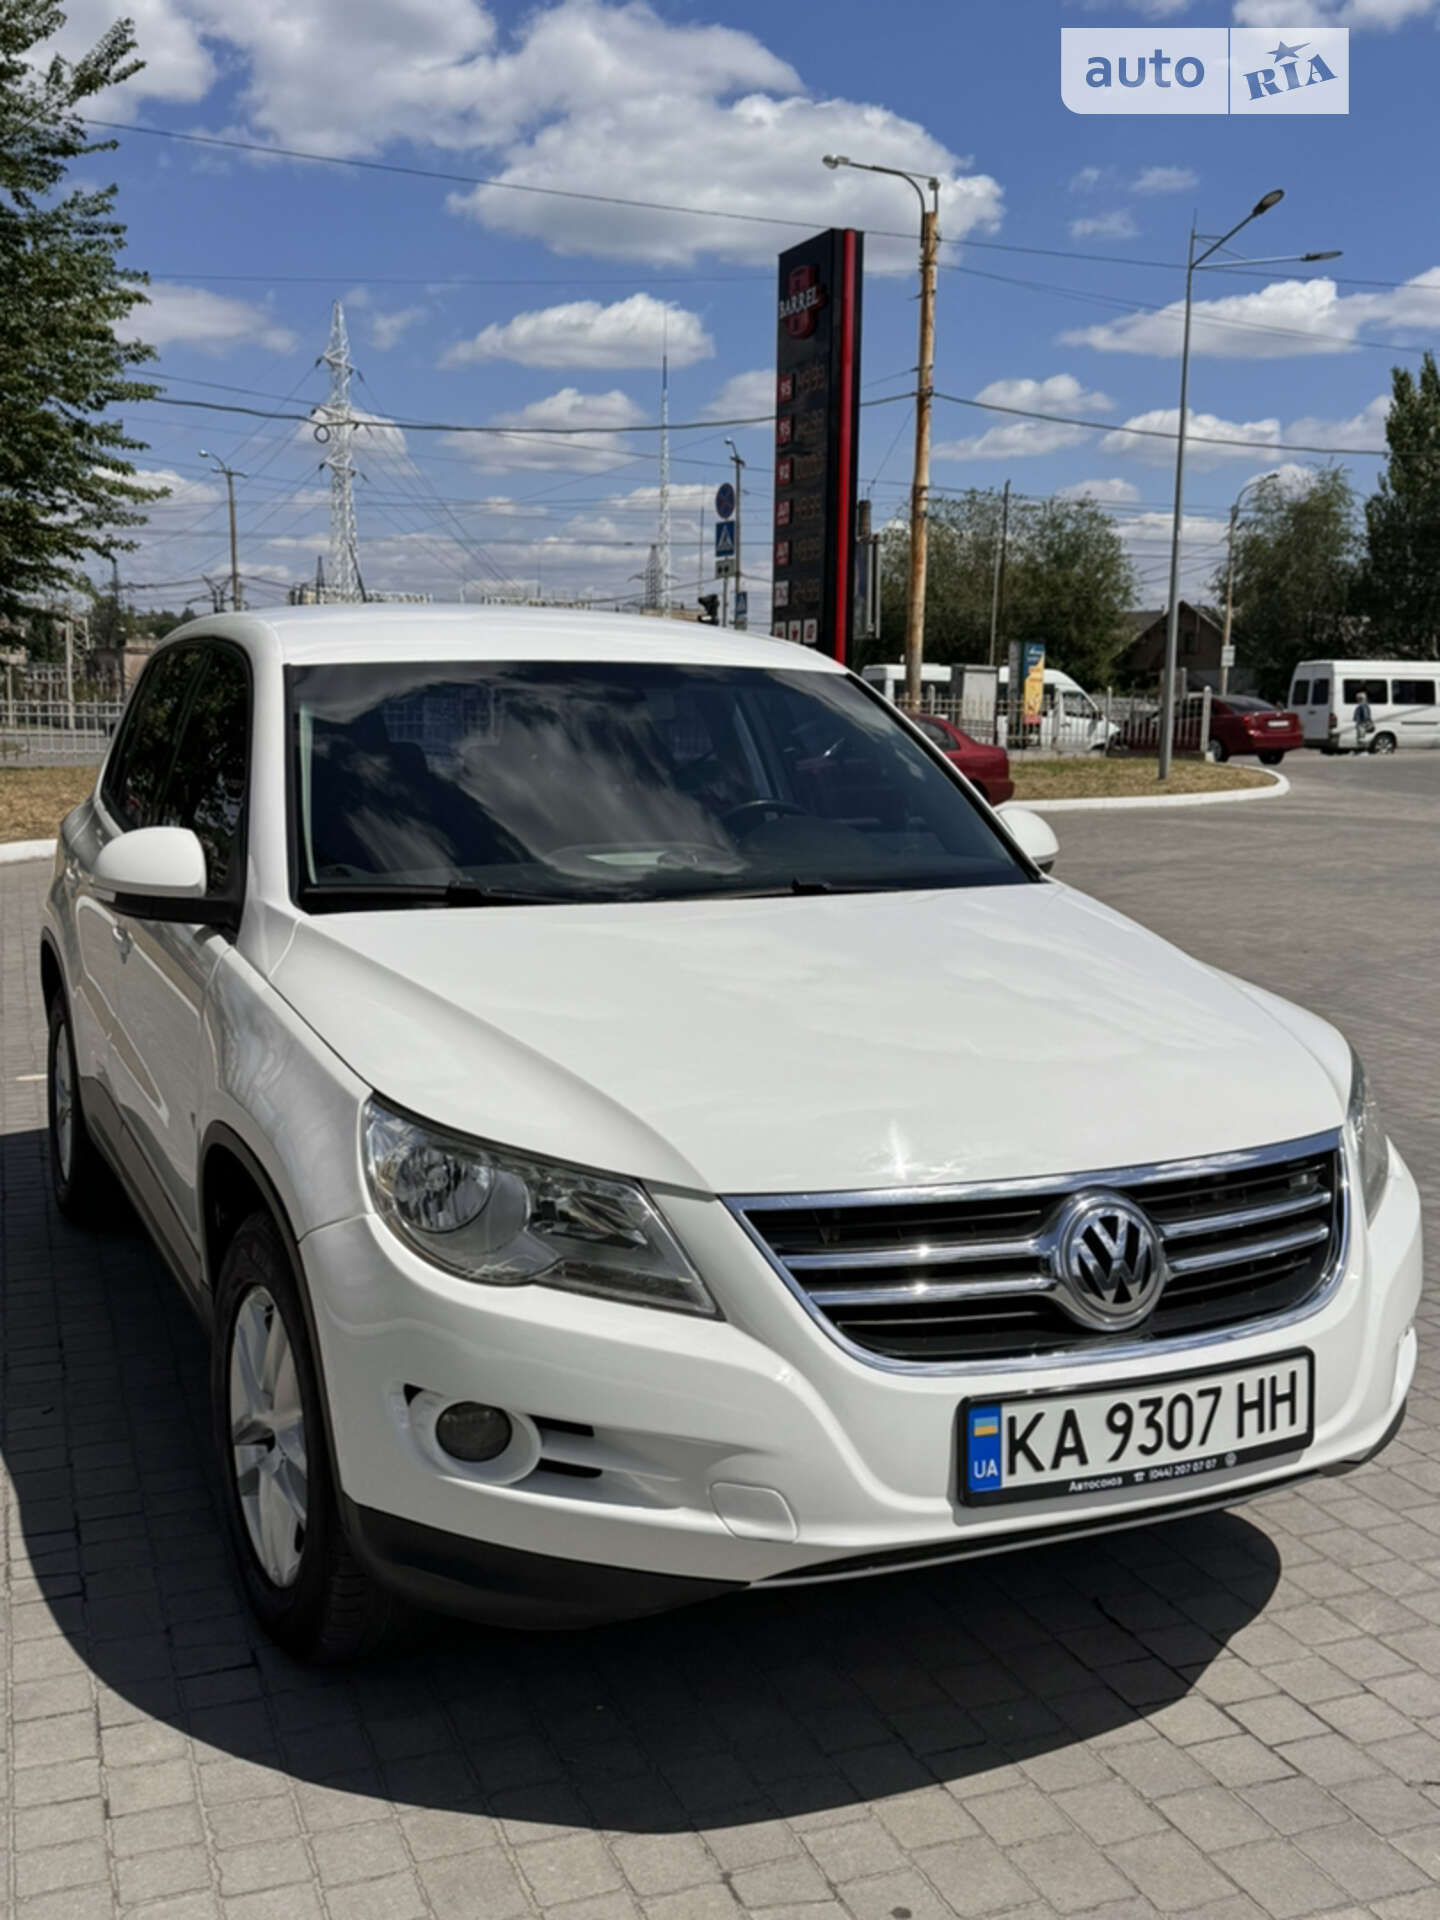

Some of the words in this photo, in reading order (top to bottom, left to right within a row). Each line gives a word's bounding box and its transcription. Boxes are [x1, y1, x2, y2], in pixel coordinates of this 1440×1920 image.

[778, 286, 819, 320] BARREL
[1007, 1408, 1089, 1476] KA
[1105, 1386, 1222, 1463] 9307
[973, 1459, 999, 1479] UA
[1068, 1475, 1123, 1493] Автосоюз
[1149, 1466, 1173, 1481] (044)
[1174, 1463, 1191, 1477] 207
